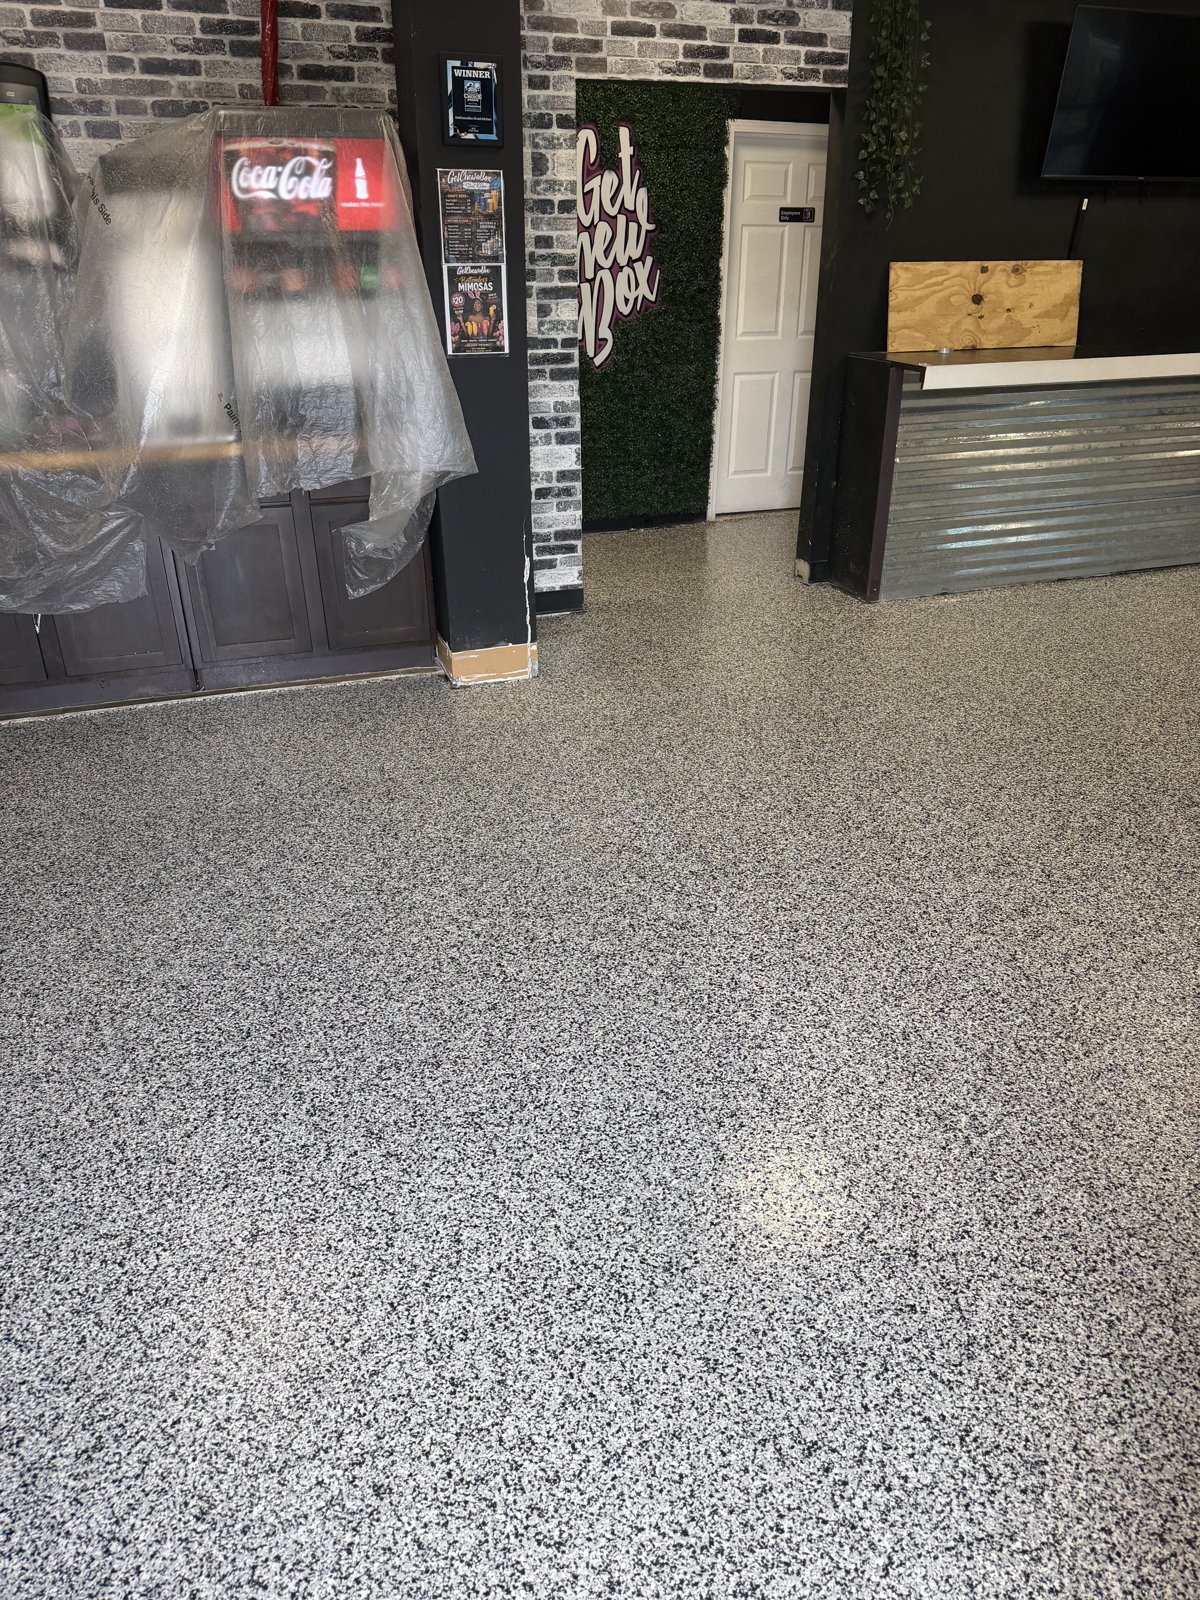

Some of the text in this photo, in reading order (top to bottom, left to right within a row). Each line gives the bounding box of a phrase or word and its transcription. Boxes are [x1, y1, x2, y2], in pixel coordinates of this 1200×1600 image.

[453, 68, 491, 79] WINNER
[231, 156, 334, 200] Coca-Cola
[577, 126, 640, 228] Get
[98, 203, 112, 226] Side
[458, 282, 494, 292] MIMOSAS
